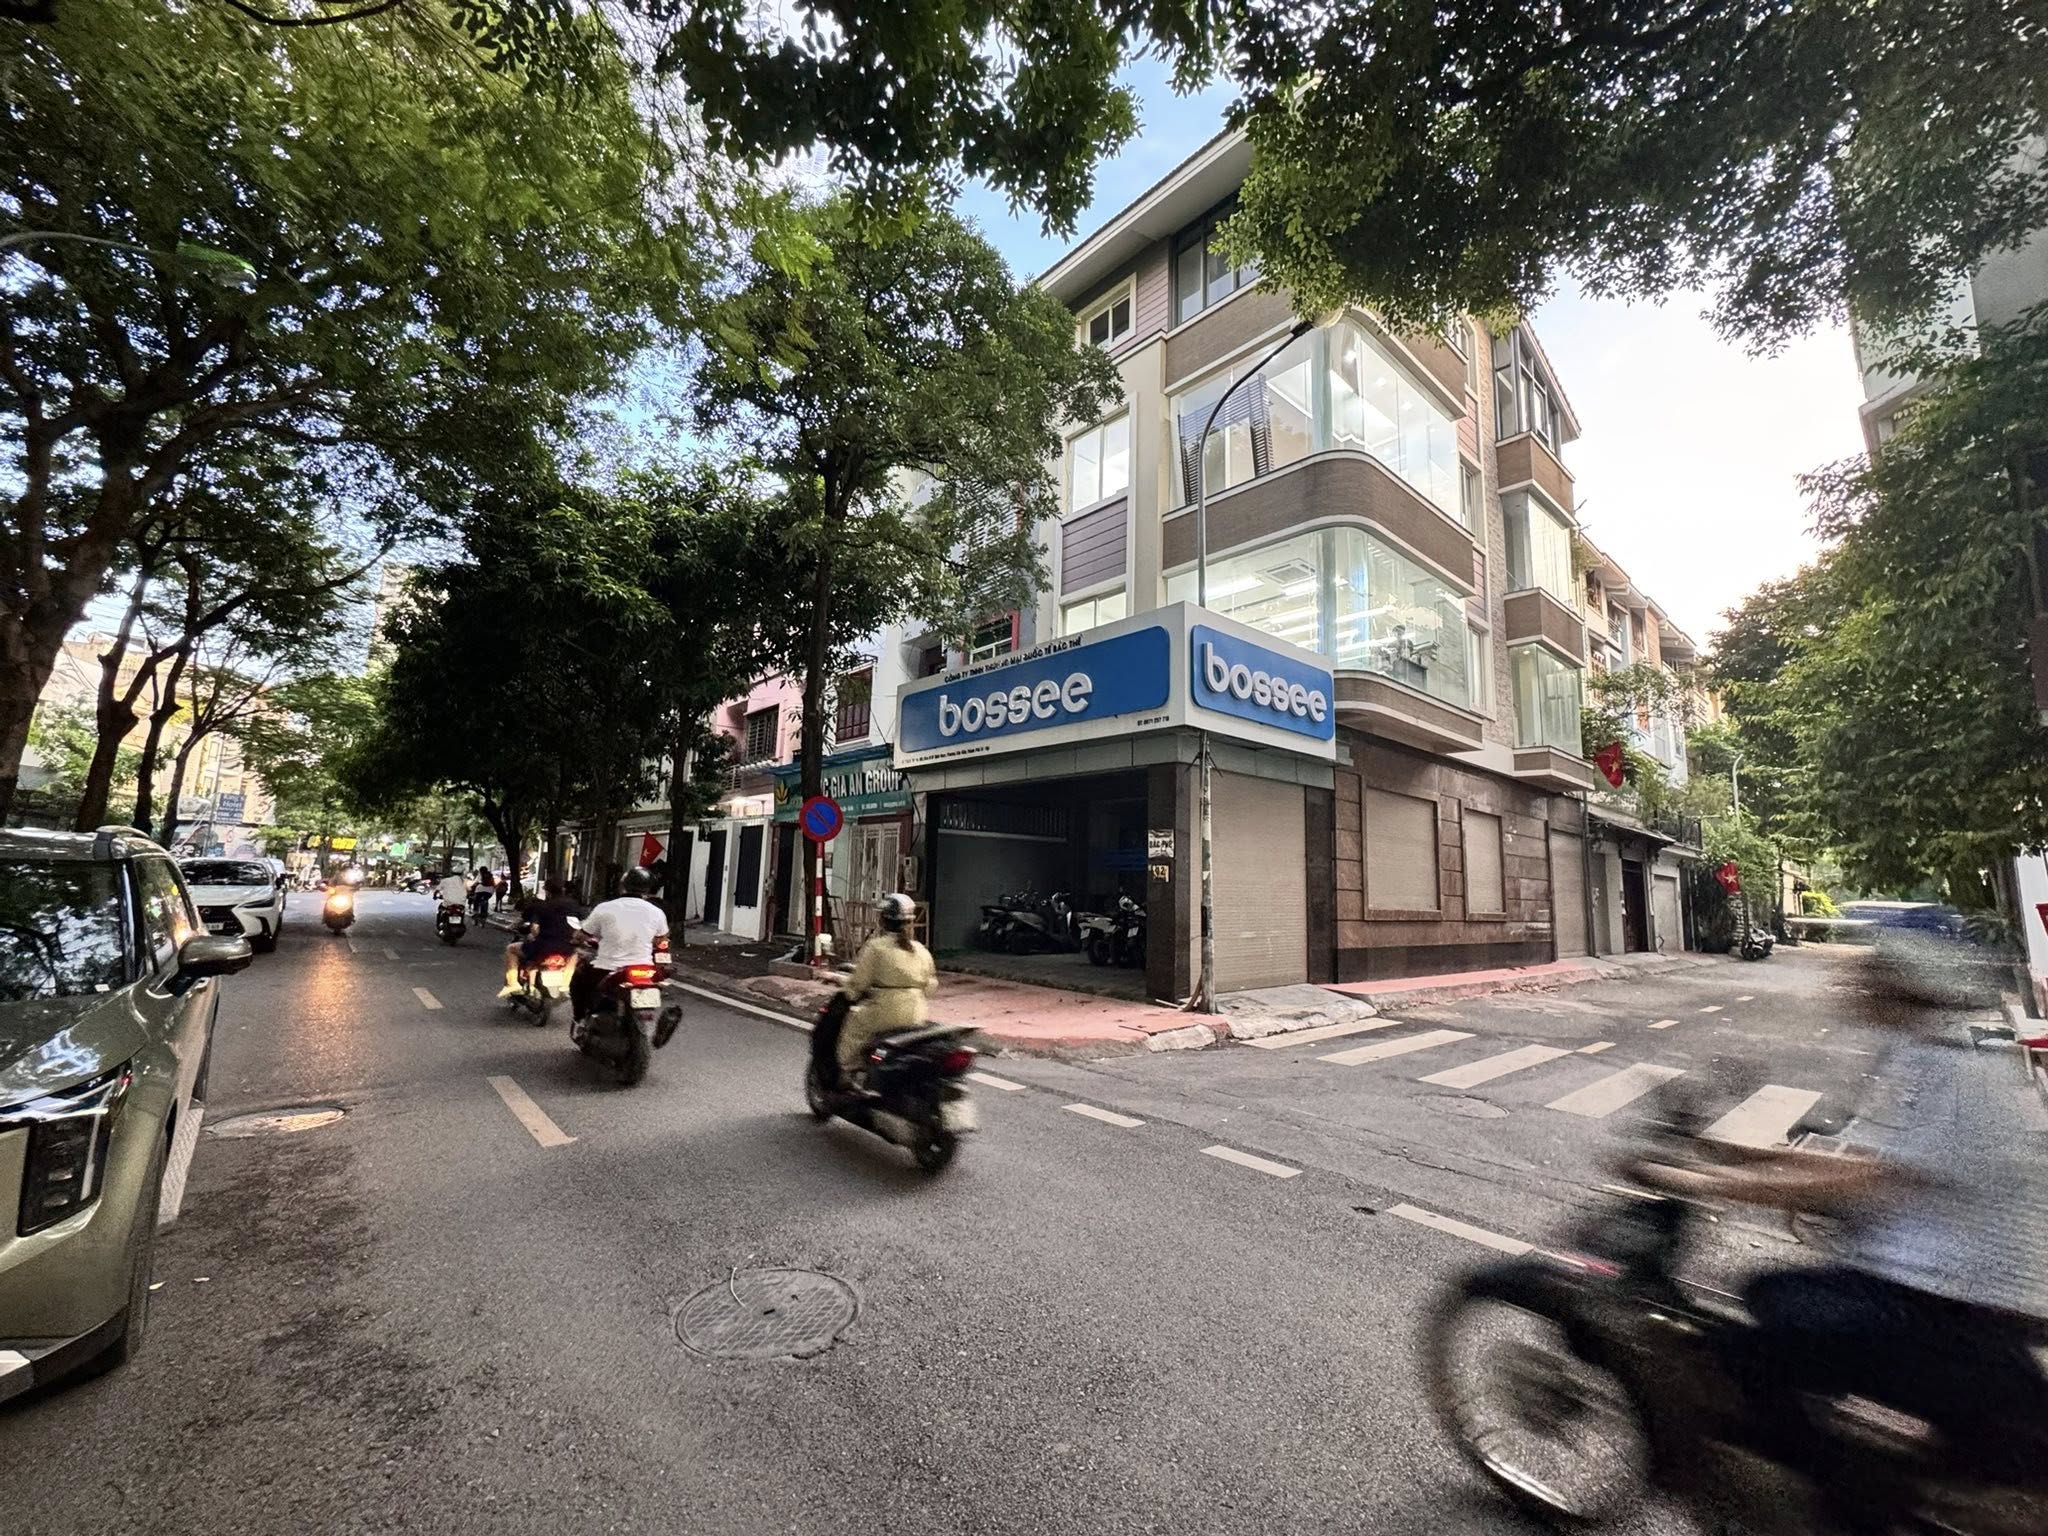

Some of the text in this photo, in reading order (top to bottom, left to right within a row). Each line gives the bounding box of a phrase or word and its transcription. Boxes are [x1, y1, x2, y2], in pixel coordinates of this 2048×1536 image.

[961, 670, 969, 679] TY
[1203, 641, 1327, 722] bossee
[939, 672, 1093, 737] bossee
[830, 774, 848, 799] GIA
[849, 771, 863, 796] AN
[865, 768, 903, 794] GROUP
